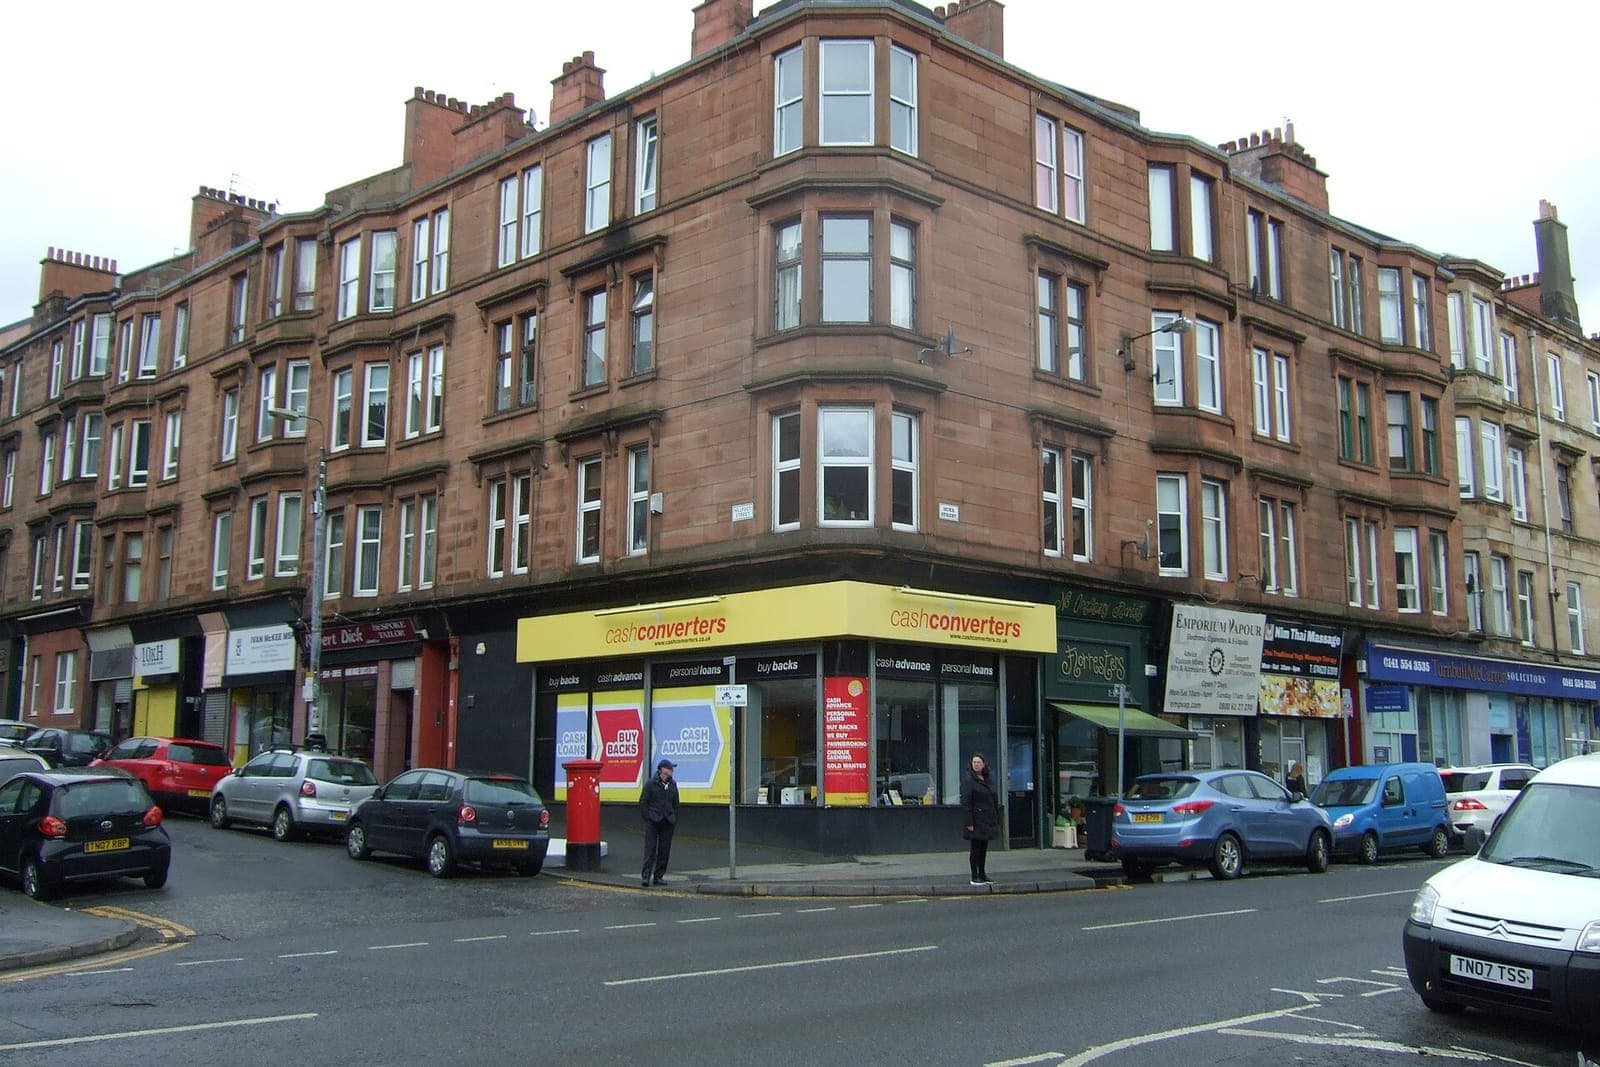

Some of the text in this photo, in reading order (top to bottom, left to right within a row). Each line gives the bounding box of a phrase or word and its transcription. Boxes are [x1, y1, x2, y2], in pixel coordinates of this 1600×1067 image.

[890, 608, 1021, 637] cashconverters
[1176, 613, 1262, 637] EMPORIUM VAPOUR
[378, 630, 405, 639] TAILOR
[606, 617, 726, 644] cashconverters
[305, 627, 364, 648] Rert Dick
[654, 636, 711, 646] www.cashconverters.co.uk
[950, 633, 1008, 643] www.cashconverters.co.uk
[1290, 628, 1307, 642] Thai
[1306, 630, 1341, 648] Massage
[757, 659, 798, 674] buy backs
[876, 657, 931, 672] cash advance
[941, 662, 993, 676] personal loans
[1383, 657, 1398, 669] 0141
[1400, 658, 1412, 670] 554
[597, 672, 643, 683] cash advance
[670, 664, 721, 679] personal loans
[549, 675, 580, 688] buy backs
[1507, 672, 1546, 685] SOLICITORS
[563, 732, 586, 744] CASH
[618, 732, 638, 742] BUY
[682, 729, 709, 740] CASH
[557, 743, 586, 756] LOANS
[607, 743, 637, 755] BACKS
[662, 741, 709, 753] ADVANCE
[90, 841, 109, 850] TN07
[1457, 957, 1527, 984] TN07 TSS
